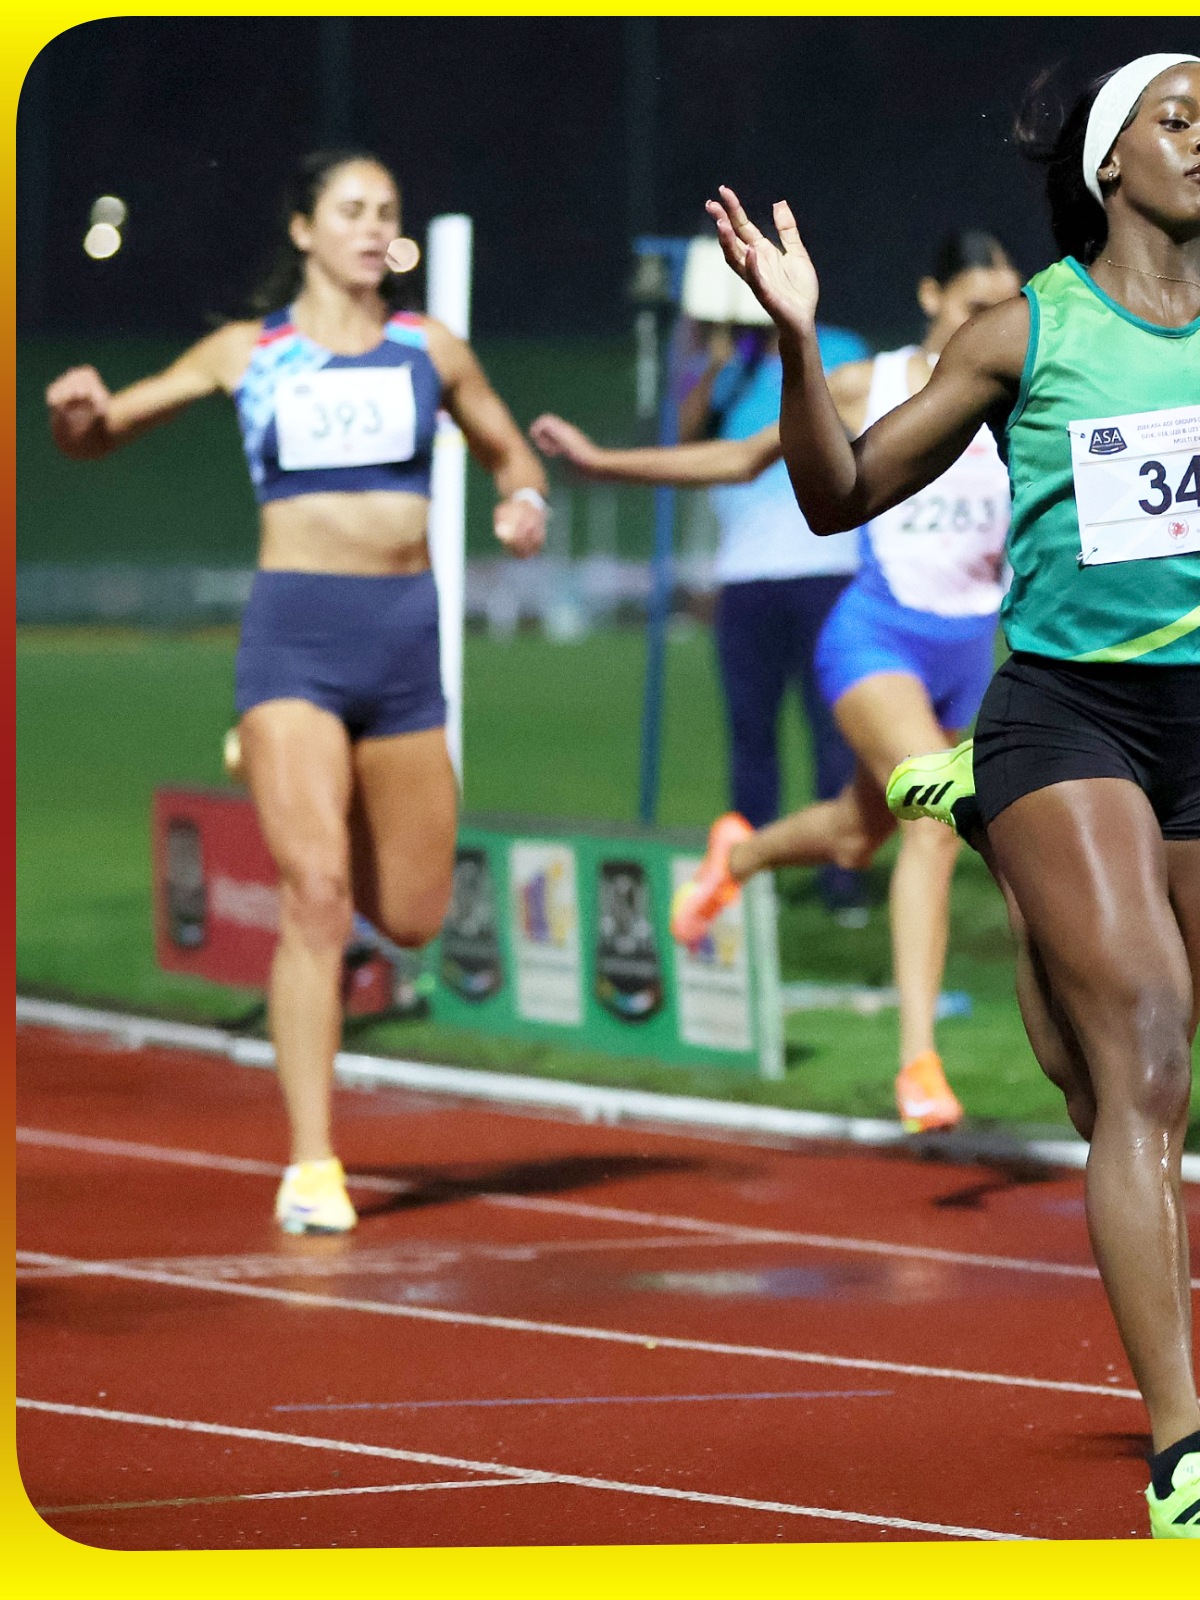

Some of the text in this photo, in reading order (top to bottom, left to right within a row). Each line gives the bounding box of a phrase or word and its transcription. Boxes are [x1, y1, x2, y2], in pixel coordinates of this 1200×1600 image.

[311, 399, 383, 439] 393
[1175, 417, 1197, 426] GROUPS
[1093, 428, 1122, 444] ASA
